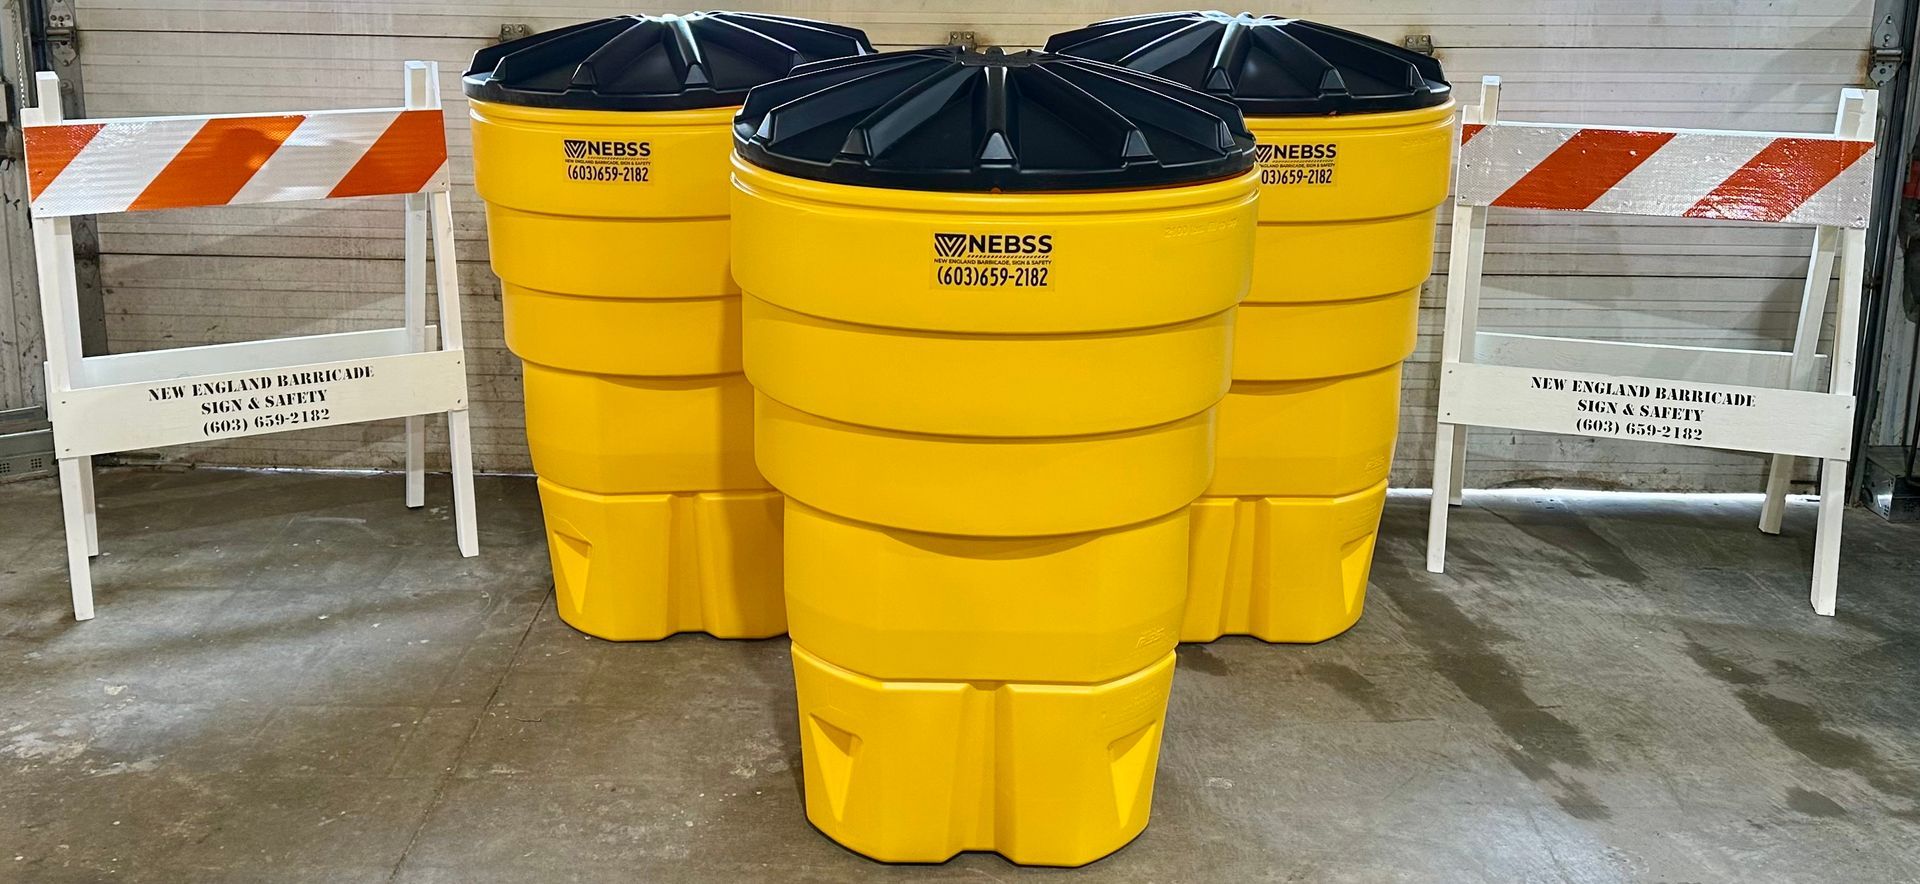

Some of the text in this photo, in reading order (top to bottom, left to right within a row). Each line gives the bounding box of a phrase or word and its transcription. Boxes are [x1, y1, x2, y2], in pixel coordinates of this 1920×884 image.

[588, 141, 651, 156] NEBSS
[1274, 144, 1336, 159] NEBSS
[568, 165, 648, 181] (603)659-2182
[1261, 169, 1332, 184] 03)659-2182
[969, 235, 1052, 253] NEBSS
[938, 266, 1048, 286] (603)659-2182
[148, 365, 375, 402] NEW ENGLAND BARRICADE
[1531, 376, 1757, 407] NEW ENGLAND BARRICADE
[201, 389, 328, 415] SIGN & SAFETY
[1577, 399, 1705, 422] SIGN & SAFETY
[203, 408, 331, 437] (603) 659-2182
[1575, 417, 1704, 441] (603) 659-2182
